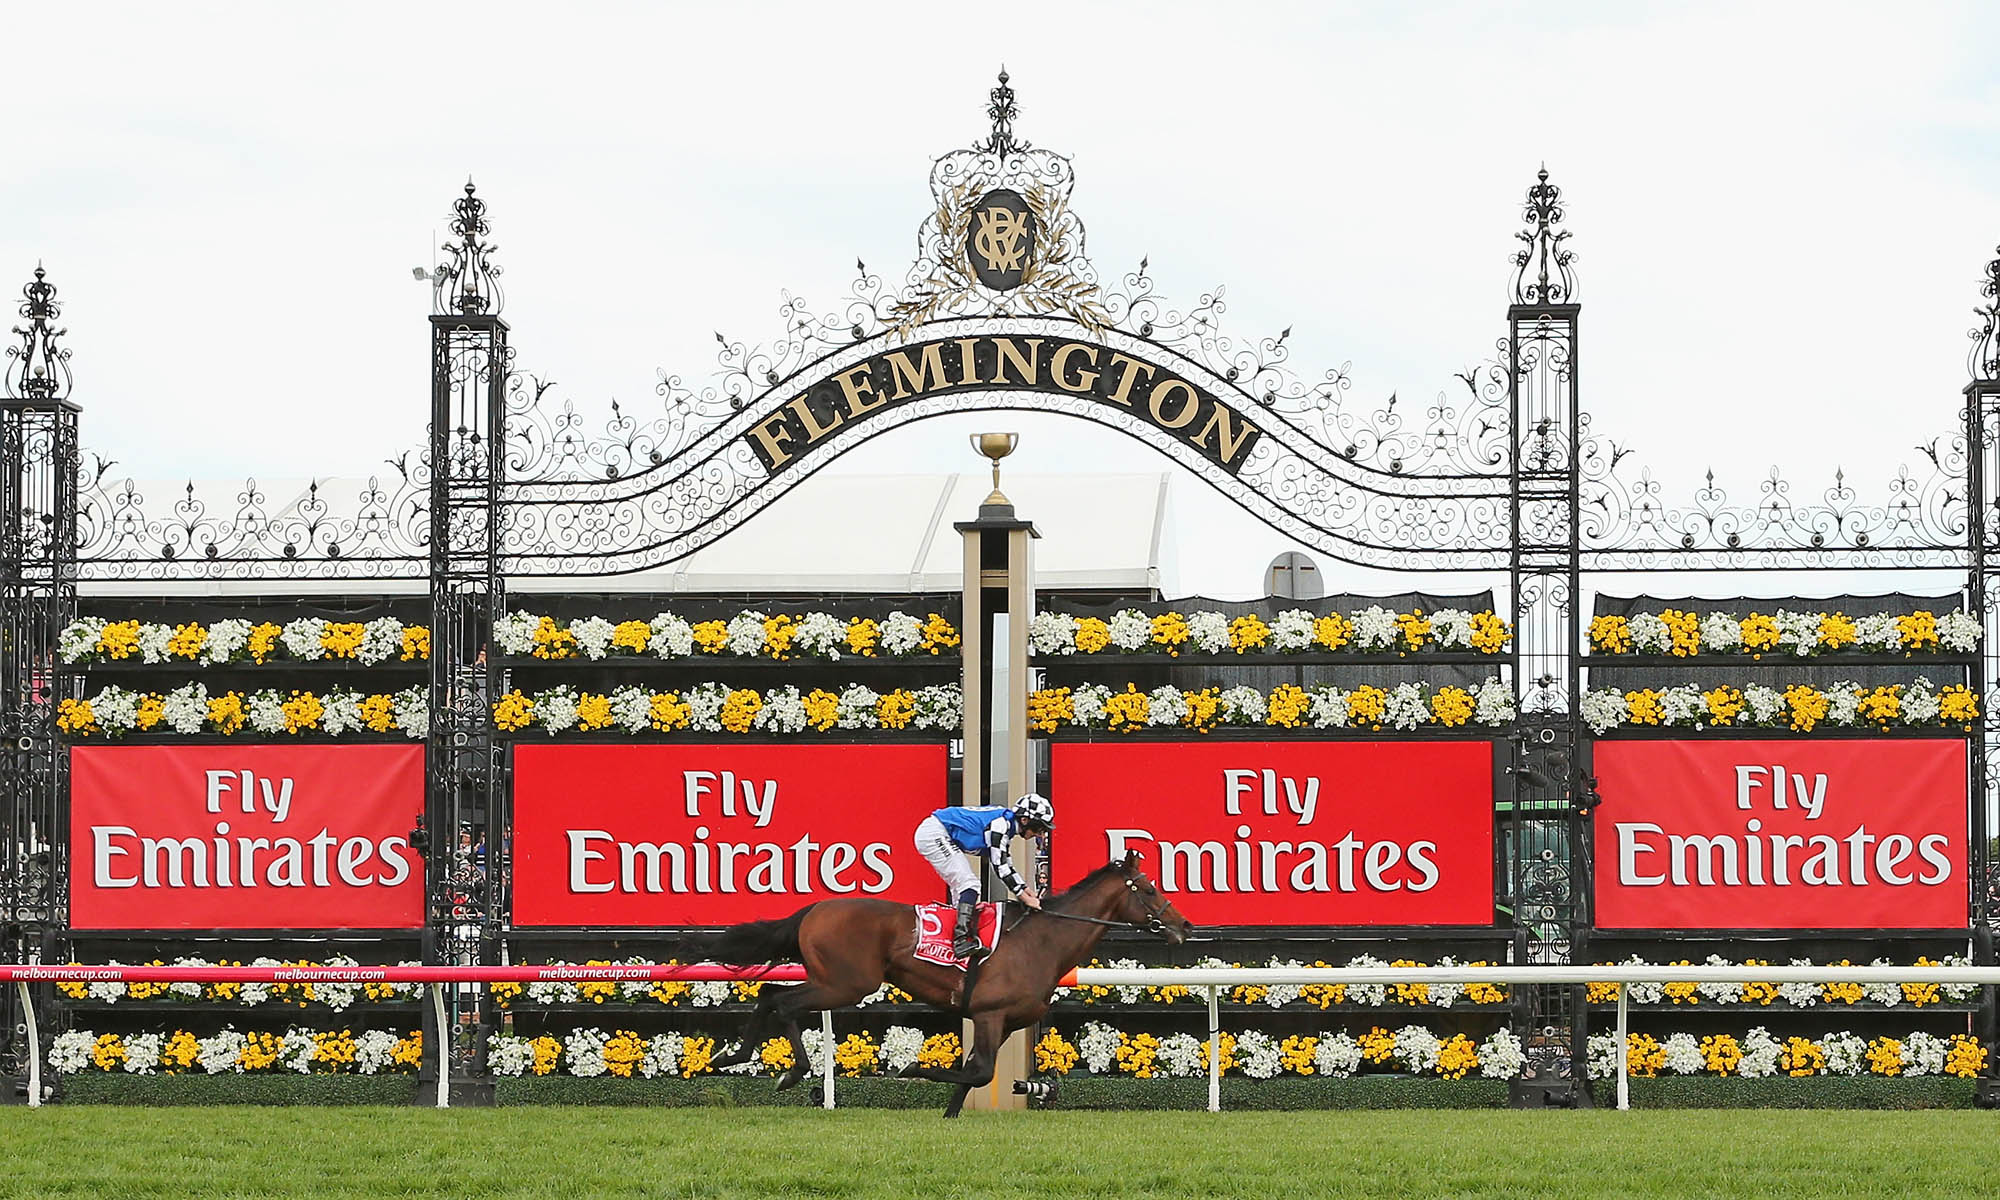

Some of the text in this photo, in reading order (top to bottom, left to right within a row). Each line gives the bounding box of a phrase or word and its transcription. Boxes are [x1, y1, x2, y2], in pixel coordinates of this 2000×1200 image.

[747, 337, 1259, 470] FLEMINGTON
[205, 769, 294, 823] Fly
[683, 770, 778, 827] Fly
[1223, 768, 1321, 825] Fly
[1734, 765, 1828, 819] Fly
[90, 822, 410, 888] Emirates
[566, 826, 894, 894] Emirates
[1105, 825, 1440, 893] Emirates
[1614, 818, 1953, 886] Emirates
[919, 907, 943, 936] 5
[11, 967, 123, 981] melbournecup.com
[273, 968, 386, 982] melbournecup.com
[538, 967, 652, 981] melbournecup.com
[918, 943, 970, 965] PROTEC
